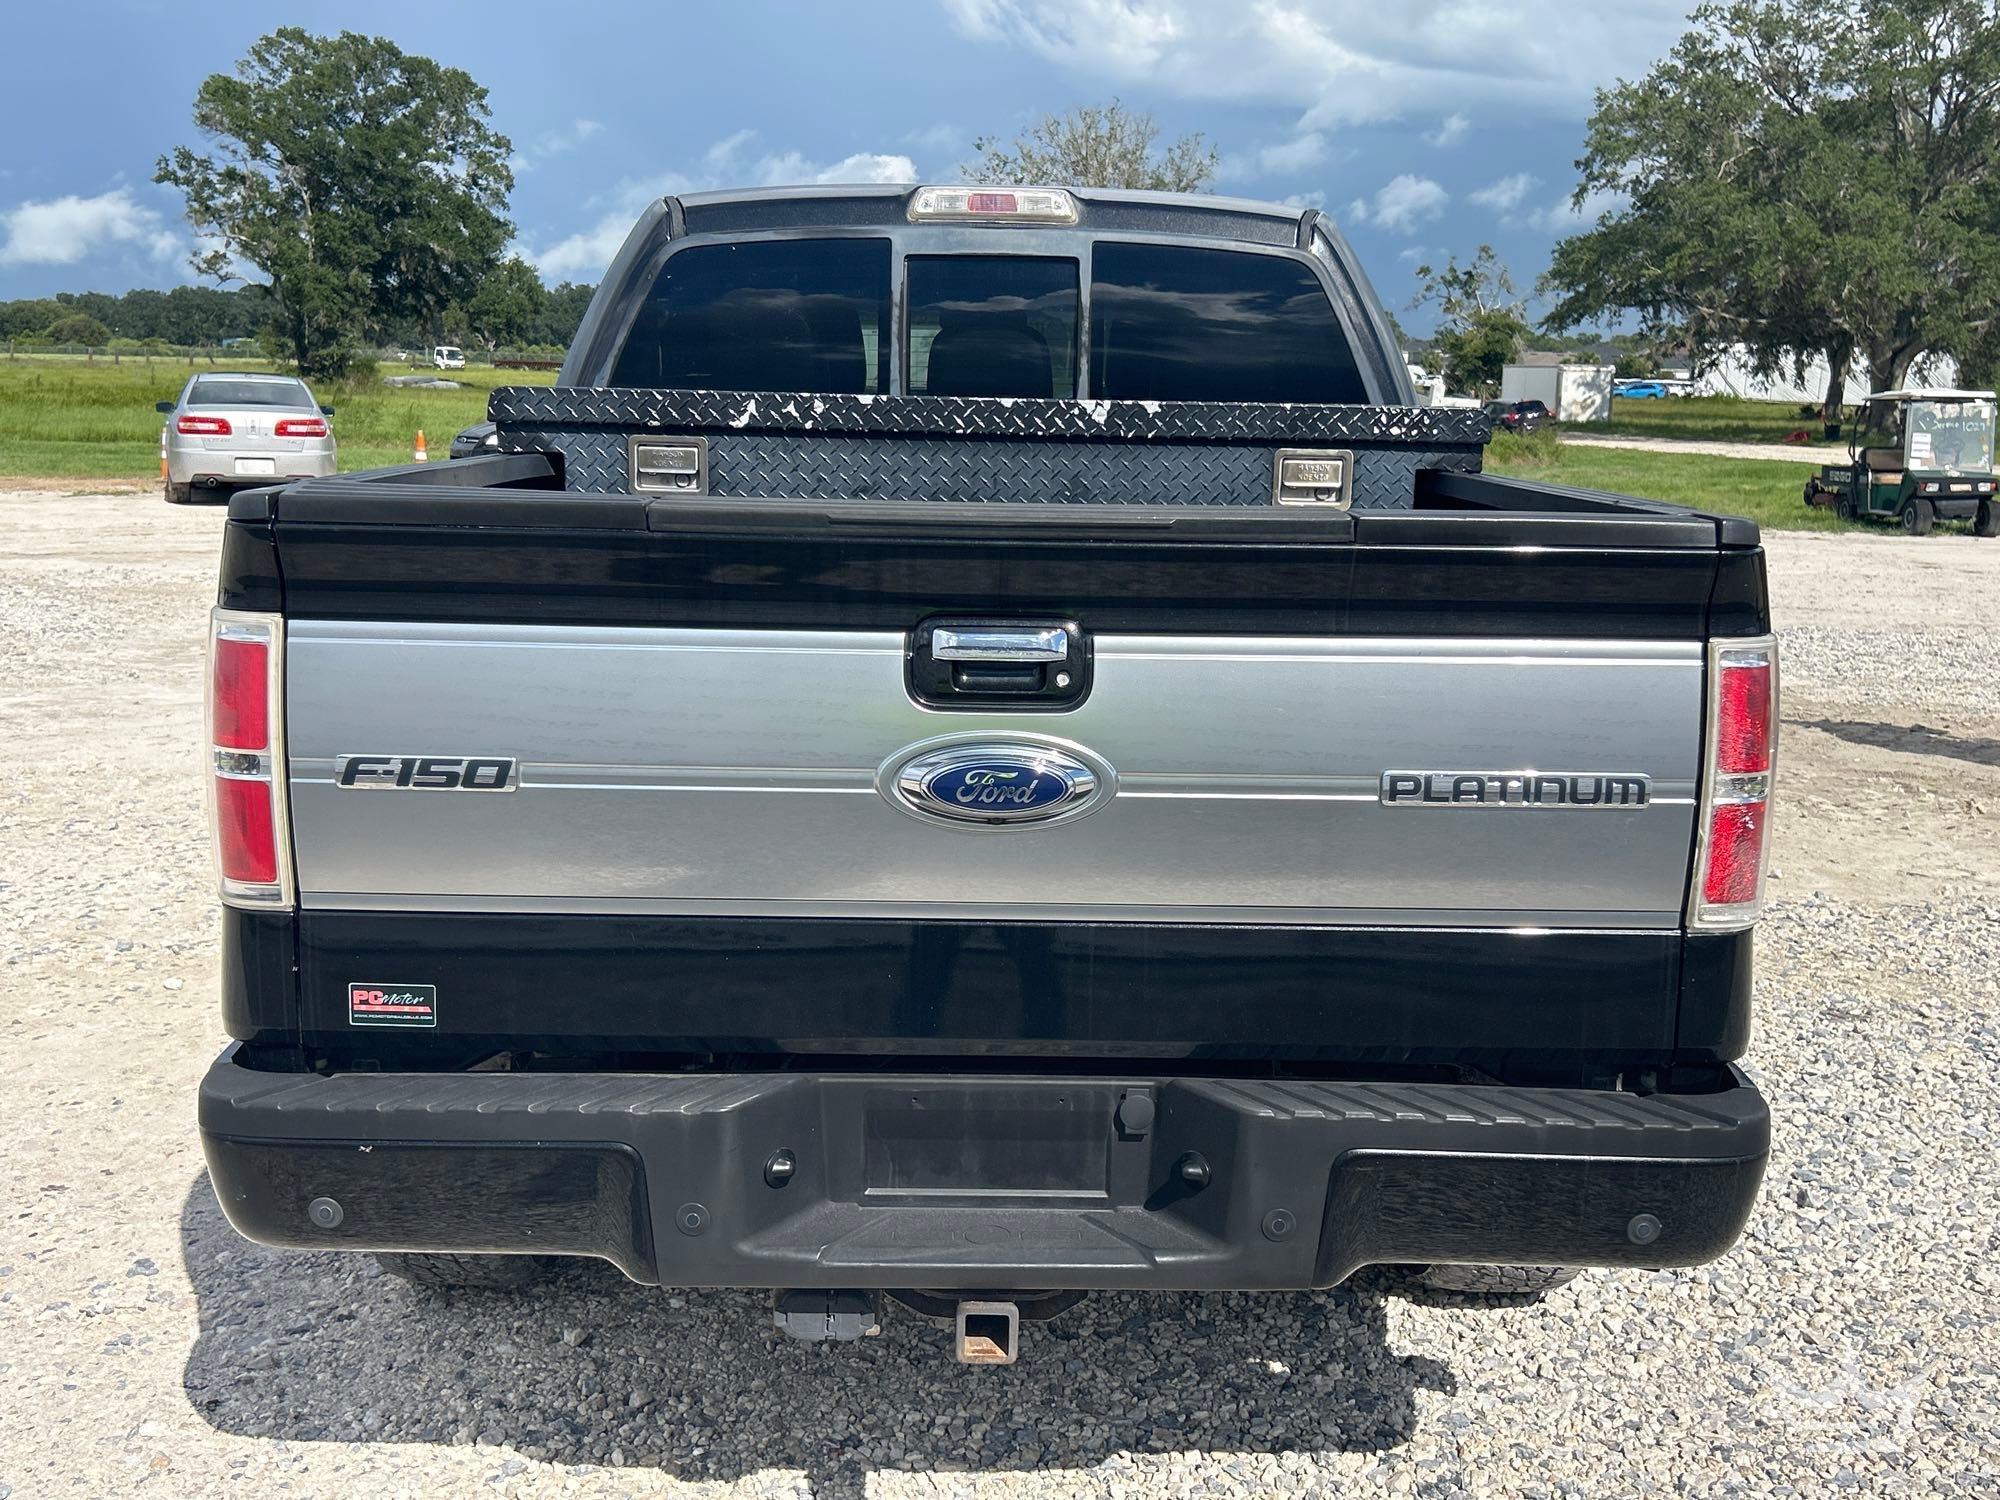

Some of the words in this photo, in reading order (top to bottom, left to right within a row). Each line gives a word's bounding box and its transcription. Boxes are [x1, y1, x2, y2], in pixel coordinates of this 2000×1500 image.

[340, 756, 513, 789] F-150
[956, 769, 1041, 804] Ford
[1388, 775, 1646, 805] PLATINUM
